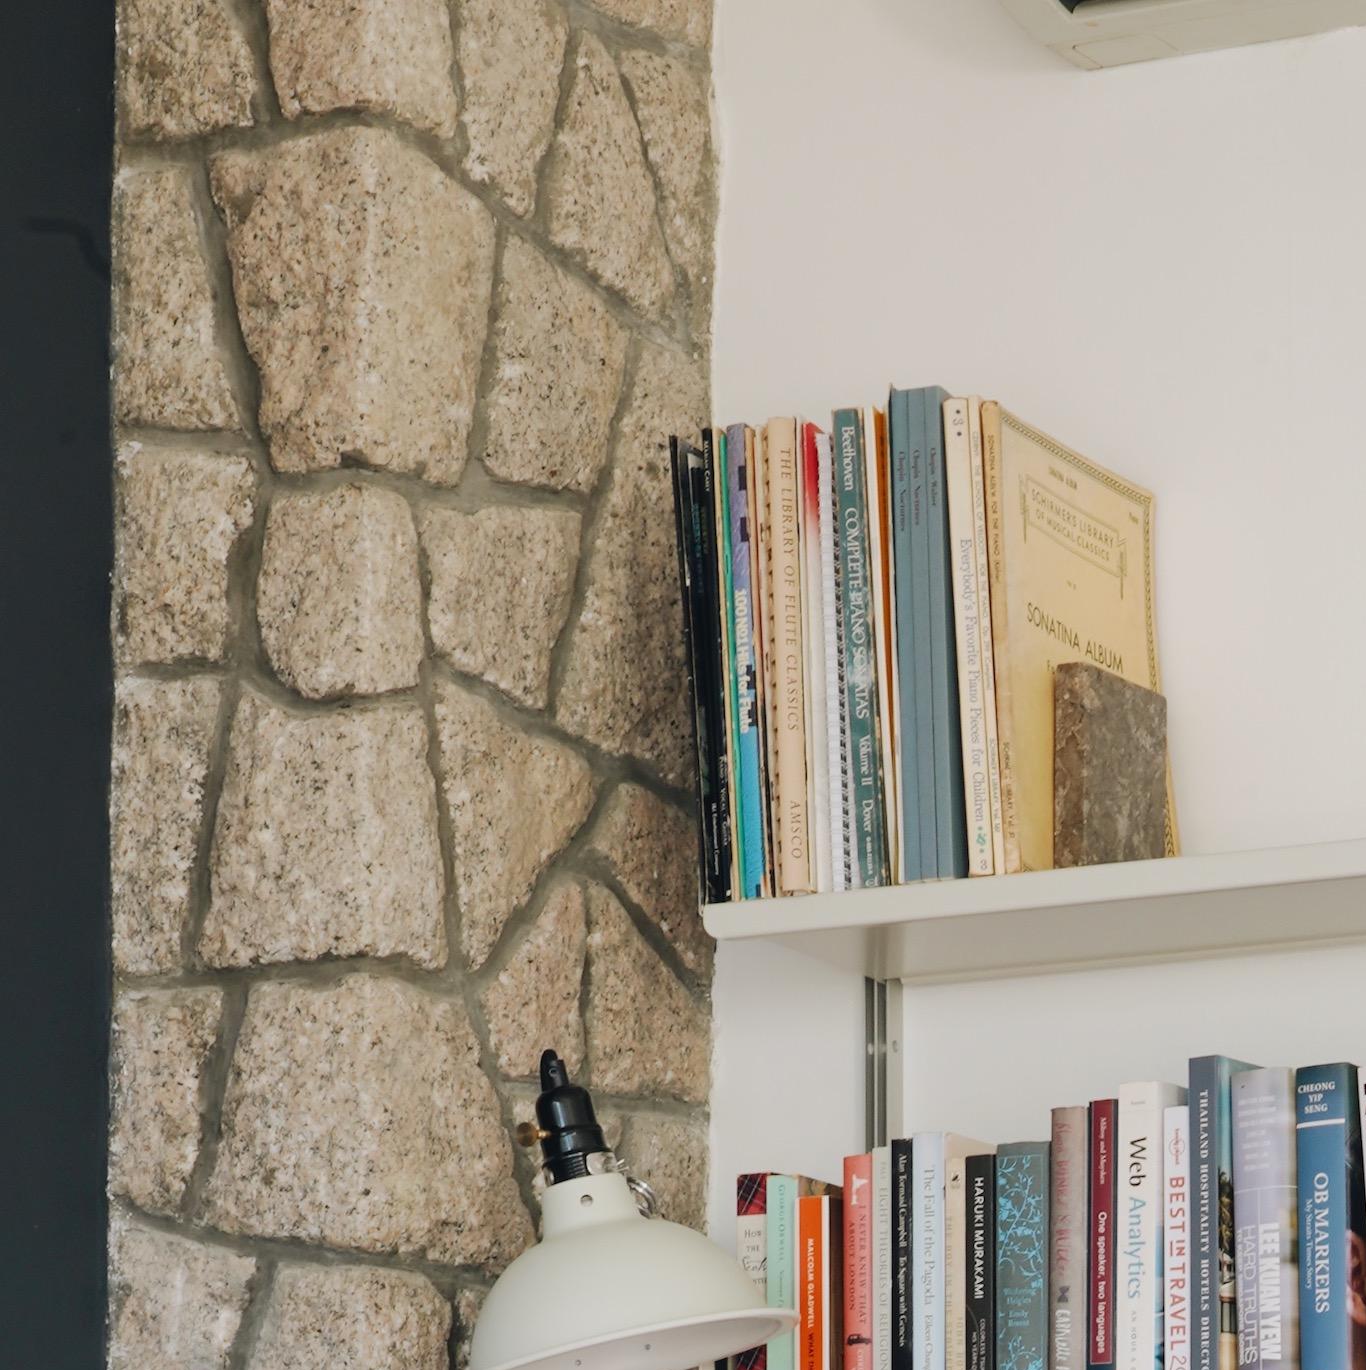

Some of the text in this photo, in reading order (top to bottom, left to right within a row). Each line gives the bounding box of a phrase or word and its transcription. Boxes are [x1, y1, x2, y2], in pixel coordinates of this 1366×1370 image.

[780, 448, 802, 859] THE LIBRARY OF FLUTE CLASSICS AMSCO
[842, 427, 875, 832] Beethoven COMPLETE PIANO SONATAS Volume II Dover
[959, 539, 987, 821] Everybody's Favorite Piano Pieces for Children
[1027, 602, 1122, 674] SONATINA ALBUM
[973, 1177, 984, 1299] HARUKI MURAKAMI
[1126, 1138, 1147, 1298] Web Analytics
[1169, 1177, 1185, 1231] BEST
[1170, 1241, 1185, 1256] IN
[1314, 1173, 1330, 1313] OB MARKERS
[1095, 1212, 1107, 1353] One speaker, two languages
[1170, 1265, 1186, 1350] TRAVEL
[1260, 1224, 1281, 1361] LEE KUAN YEW
